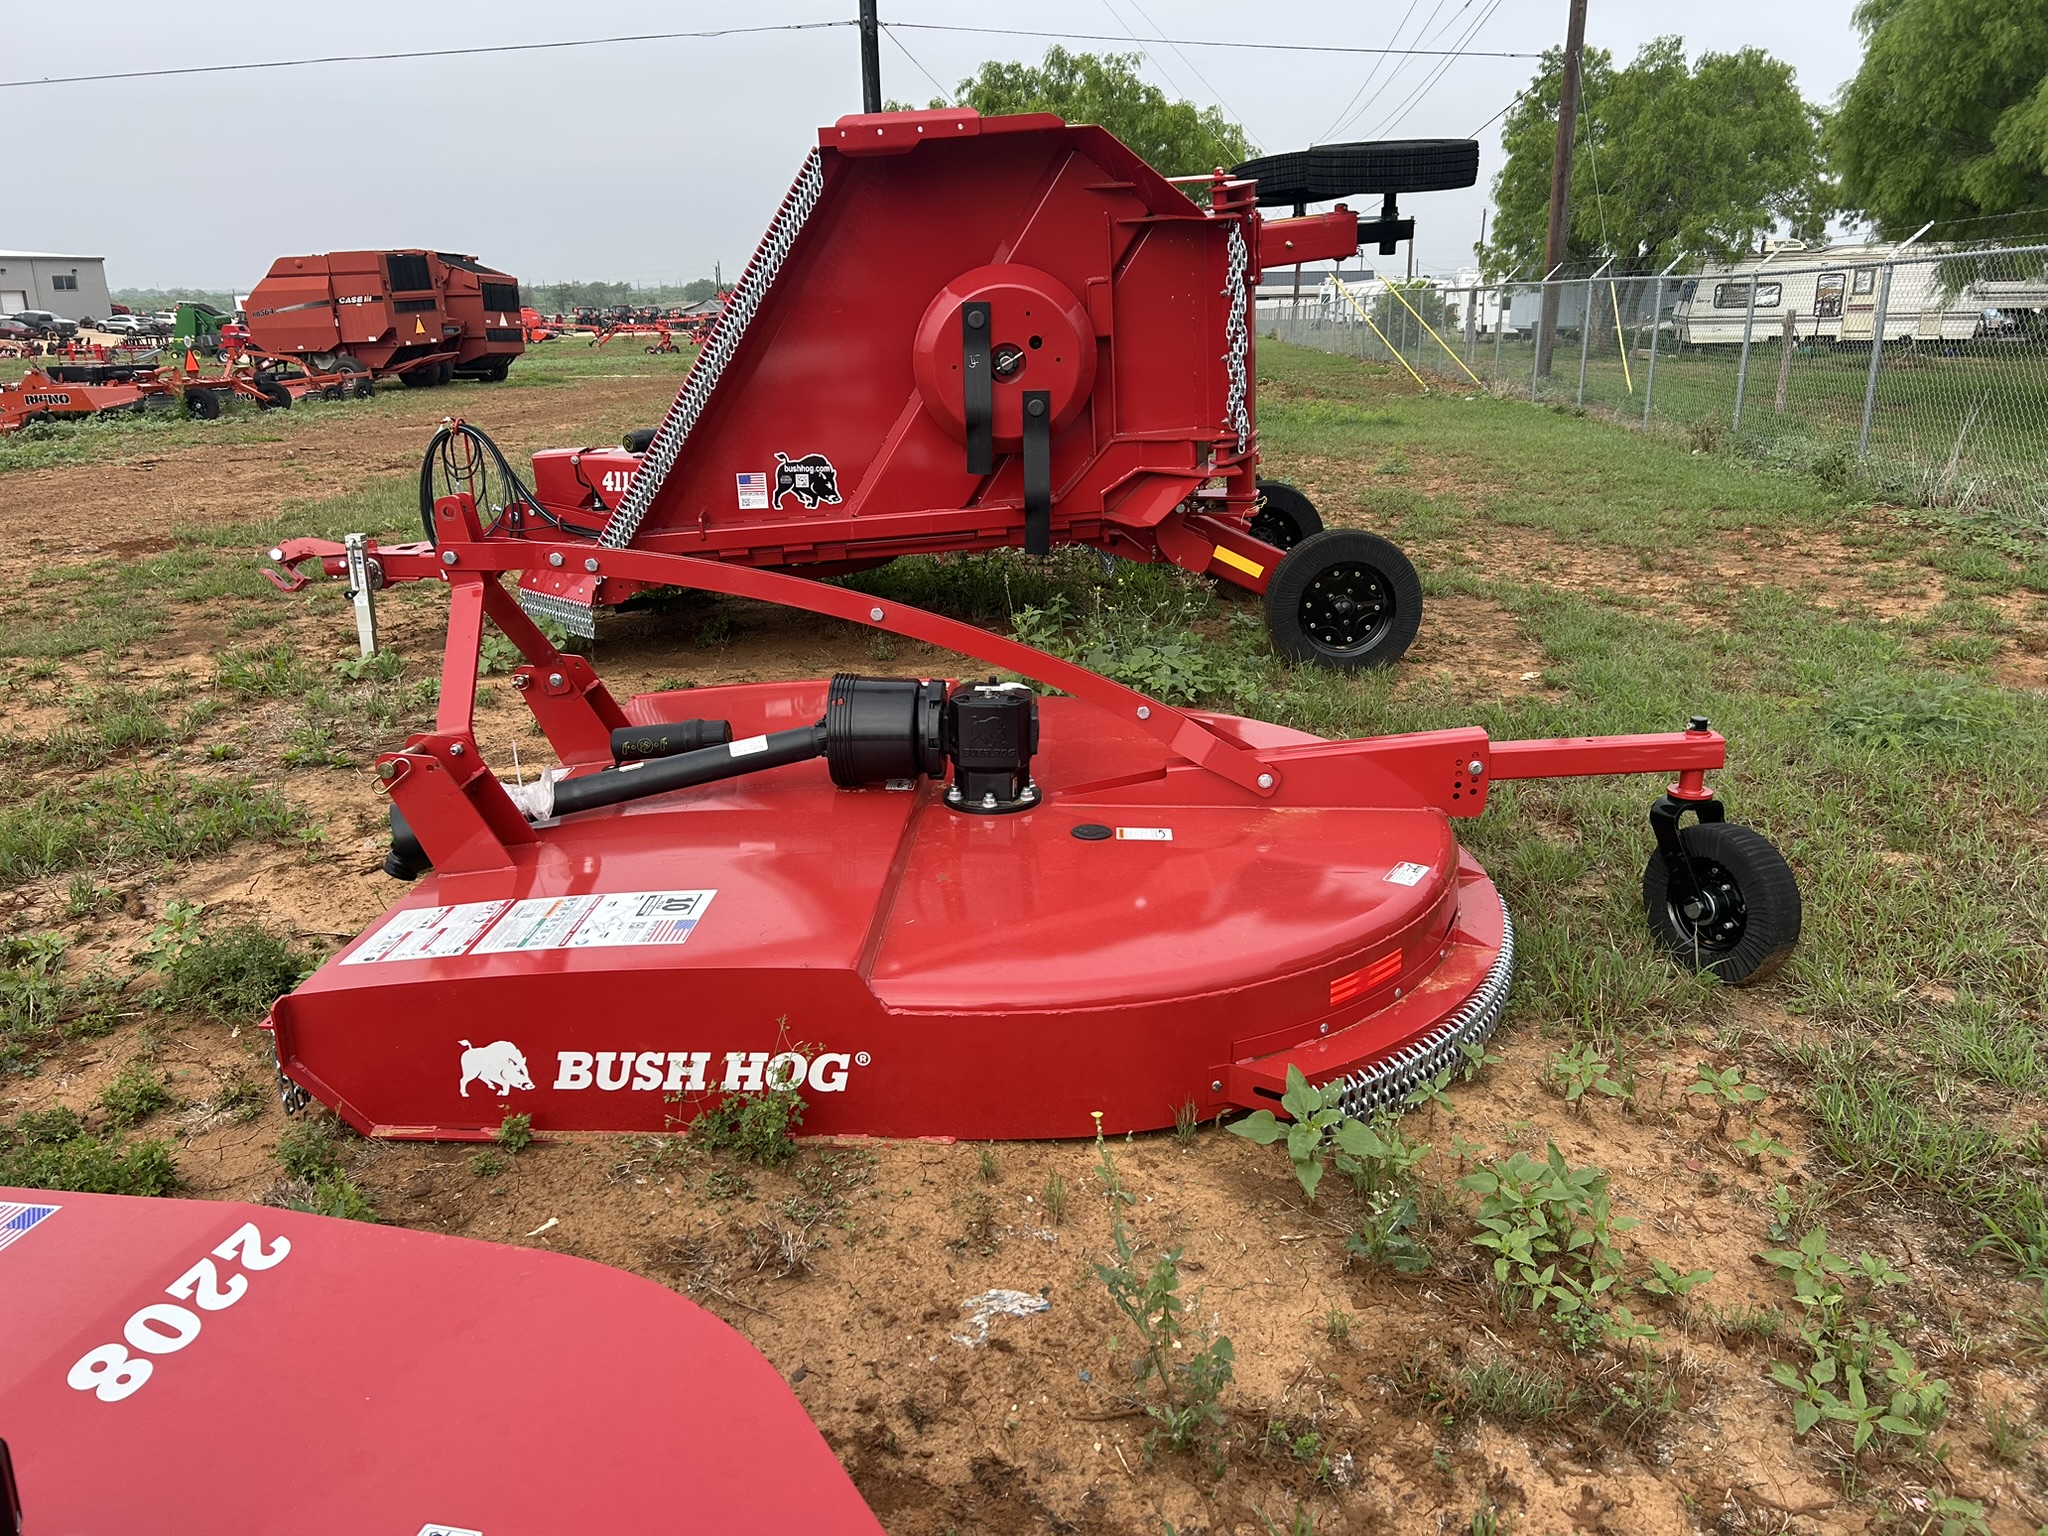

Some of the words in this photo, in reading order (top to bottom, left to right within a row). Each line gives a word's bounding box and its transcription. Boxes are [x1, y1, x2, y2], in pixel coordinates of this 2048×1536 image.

[338, 295, 363, 304] CASE
[783, 464, 830, 474] bushhog.com
[601, 470, 636, 492] 411
[661, 897, 694, 911] 10
[553, 1051, 711, 1091] BUSH
[66, 1221, 292, 1402] 2208
